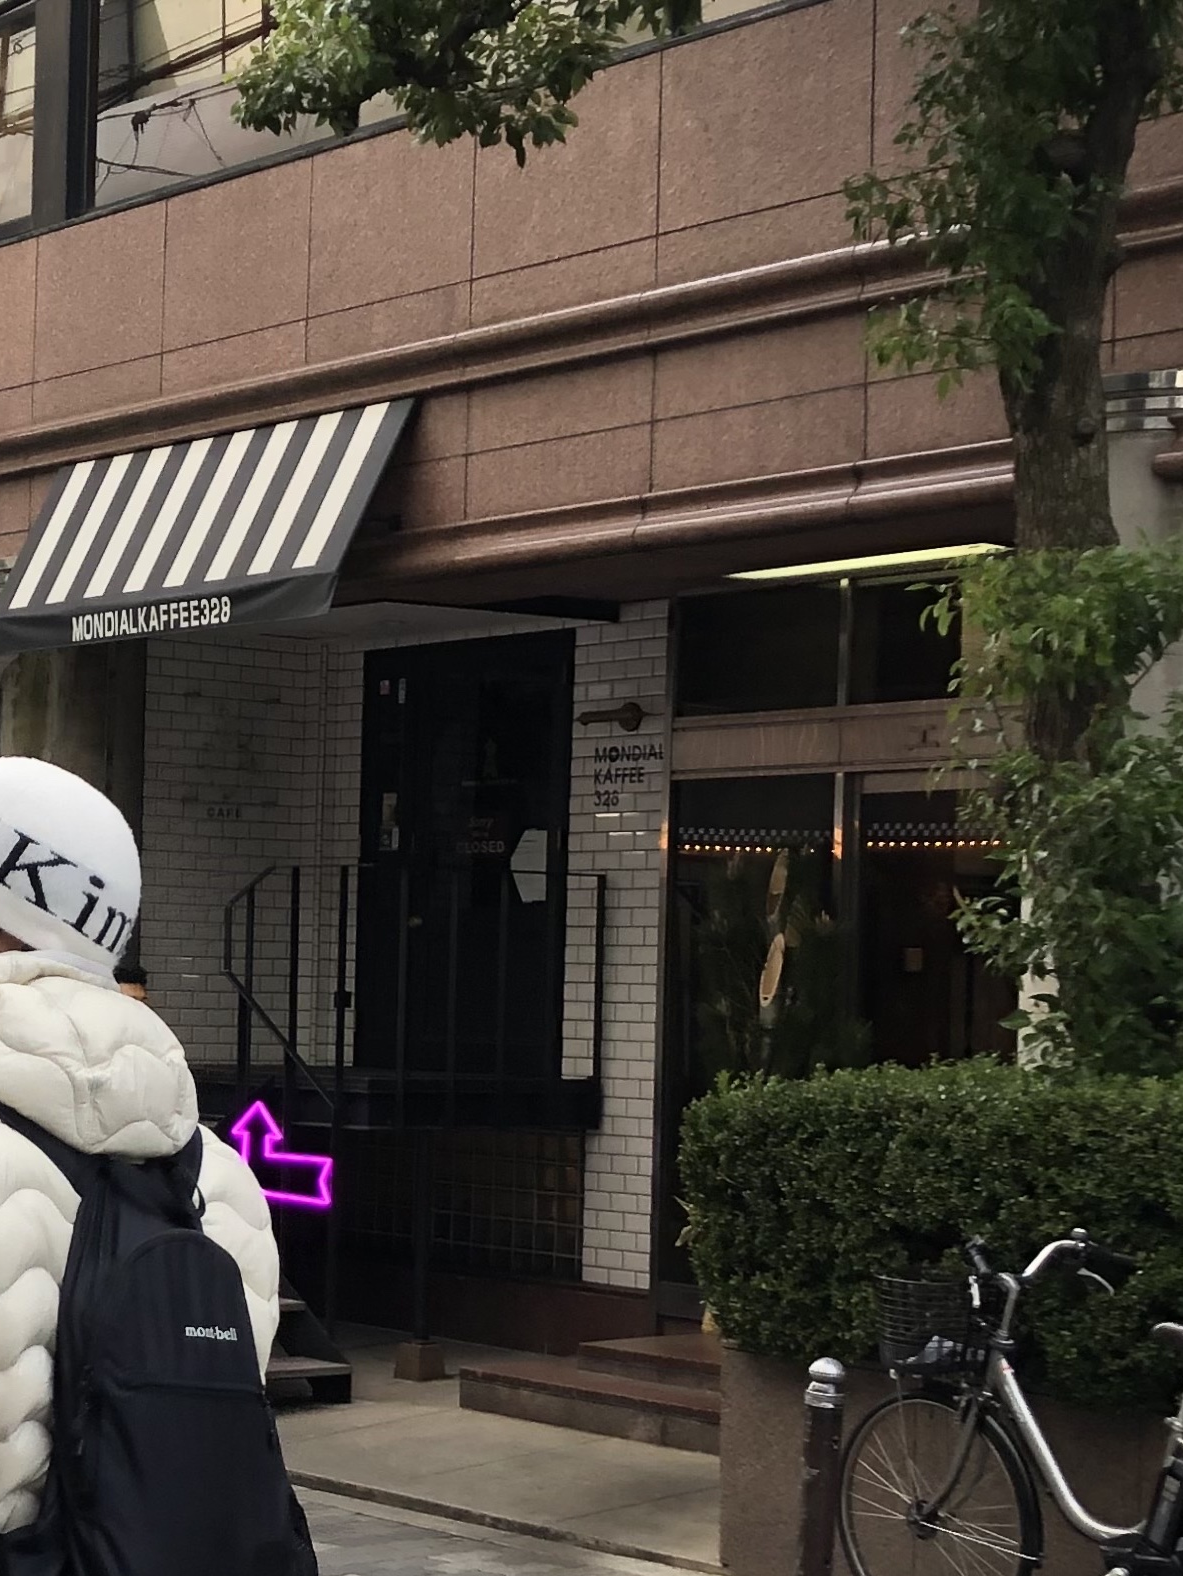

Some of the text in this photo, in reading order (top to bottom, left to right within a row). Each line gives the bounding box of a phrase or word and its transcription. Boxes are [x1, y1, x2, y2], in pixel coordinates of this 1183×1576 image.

[71, 596, 232, 642] MONDIALKAFFEE328
[594, 743, 665, 763] MONDIAL
[594, 766, 645, 784] KAFFEE
[456, 840, 505, 854] CLOSED
